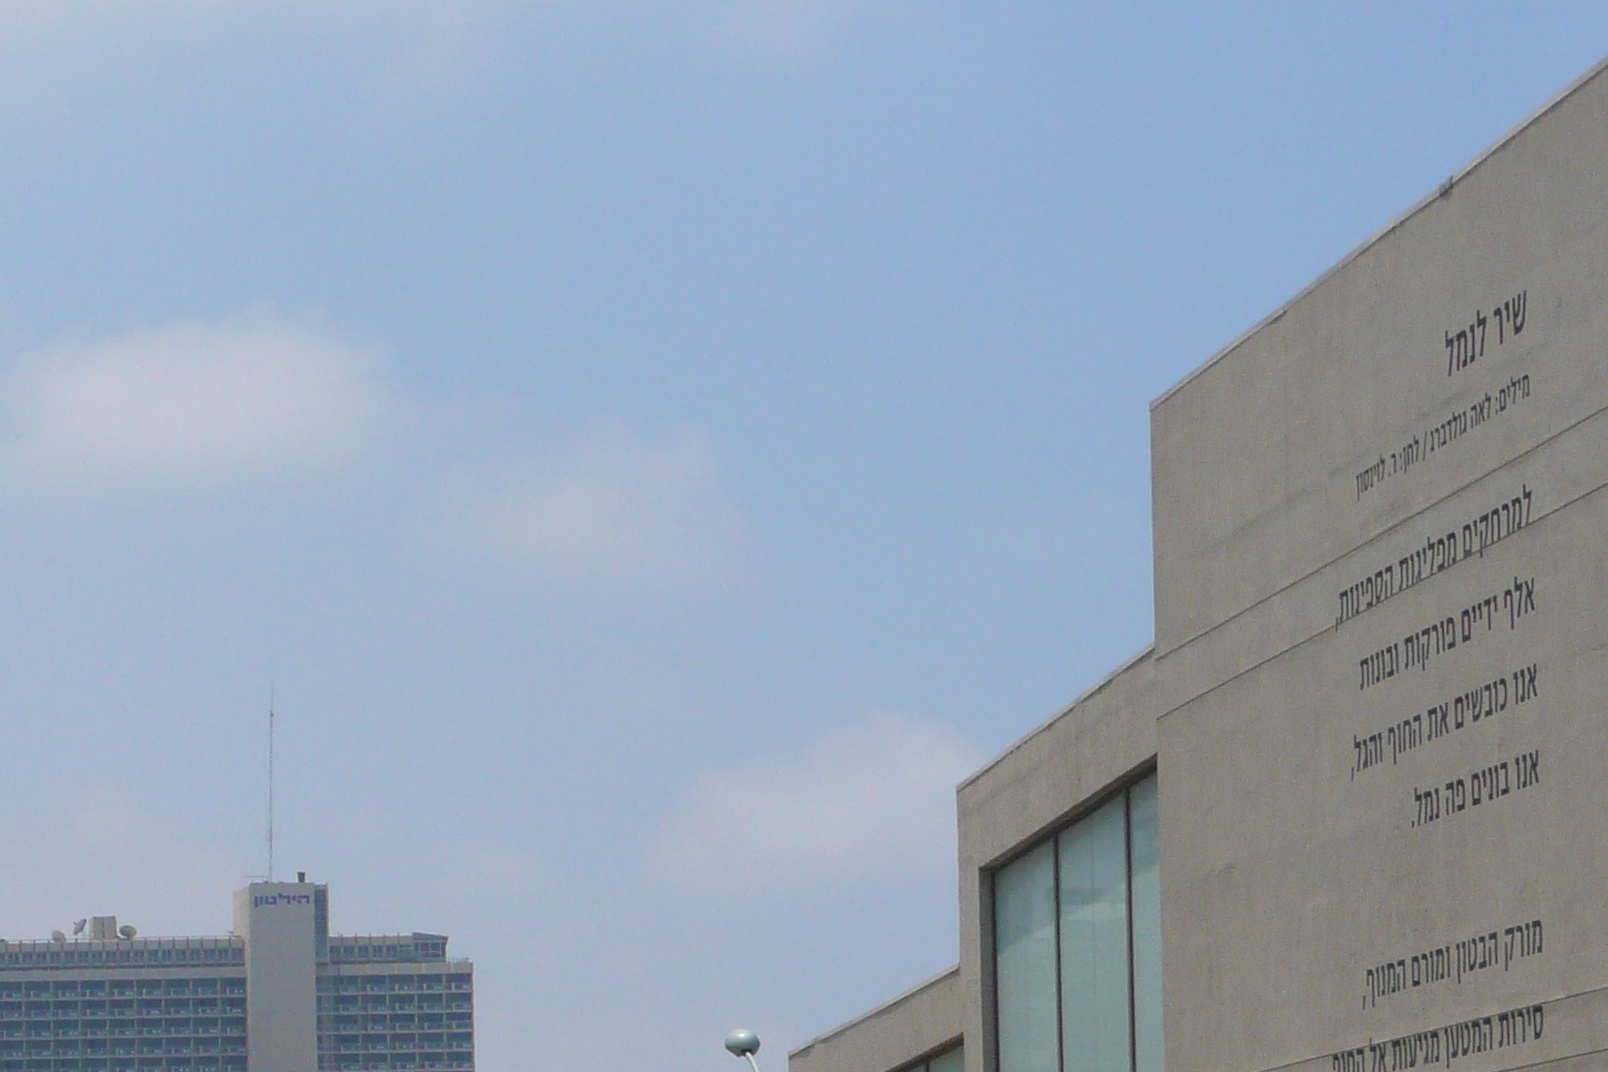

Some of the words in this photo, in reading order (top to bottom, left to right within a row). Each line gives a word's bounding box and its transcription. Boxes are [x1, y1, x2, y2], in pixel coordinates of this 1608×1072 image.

[1494, 290, 1527, 345] שיר
[1445, 309, 1487, 377] לנמל
[1470, 392, 1491, 429] לאה
[1495, 374, 1530, 415] מילים:
[1399, 435, 1420, 474] לחן:
[1430, 412, 1467, 453] גולדברג
[1355, 454, 1386, 501] לוינסון
[1463, 484, 1532, 558] למרחקים
[1399, 536, 1457, 591] מפליגות
[1335, 565, 1393, 632] הספינות,
[1461, 595, 1498, 643] ידיים
[1504, 576, 1535, 630] אלף
[1359, 643, 1399, 690] ובונות
[1404, 617, 1456, 671] פורקות
[1454, 678, 1508, 730] כובשים
[1513, 663, 1538, 705] אנו
[1388, 714, 1421, 765] החוף
[1427, 702, 1449, 741] את
[1351, 734, 1383, 782] והגל,
[1515, 750, 1540, 790] אנו
[1411, 787, 1440, 829] נמל.
[1445, 779, 1466, 816] פה
[1471, 762, 1510, 807] בונים
[254, 893, 310, 908] הילטון
[1411, 946, 1451, 987] ומורם
[1456, 932, 1498, 984] הבטון
[1505, 919, 1543, 972] מורק
[1362, 959, 1406, 1011] המנוף,
[1444, 1016, 1493, 1069] המטען
[1498, 1004, 1544, 1048] סירות
[1392, 1030, 1440, 1072] מגיעות
